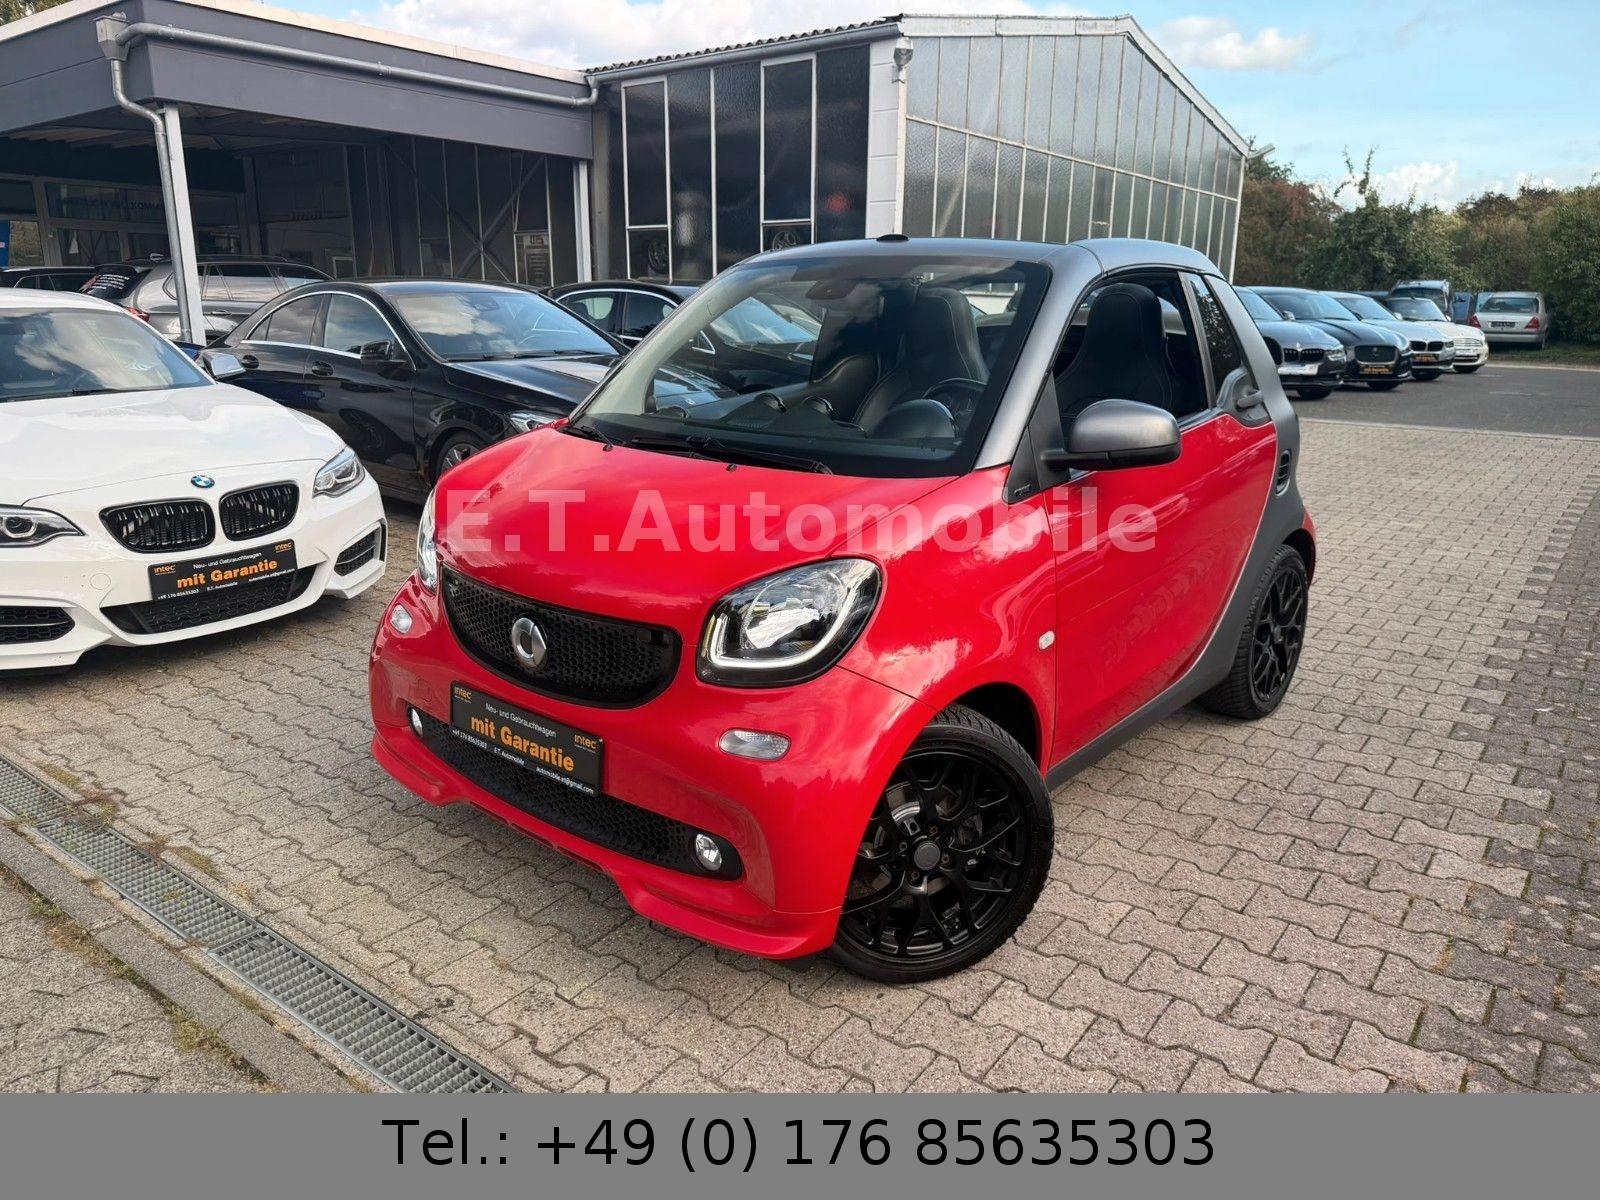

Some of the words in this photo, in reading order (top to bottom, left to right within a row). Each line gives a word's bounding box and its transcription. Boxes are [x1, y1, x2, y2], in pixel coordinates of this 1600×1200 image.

[177, 573, 206, 589] mit
[210, 560, 278, 582] Garantie
[219, 552, 262, 565] Gebrauchtwagen
[485, 702, 498, 714] Neu-
[499, 709, 510, 719] und
[510, 712, 557, 738] Gebrauchtwagen
[471, 716, 496, 740] mit
[500, 726, 574, 772] Garantie
